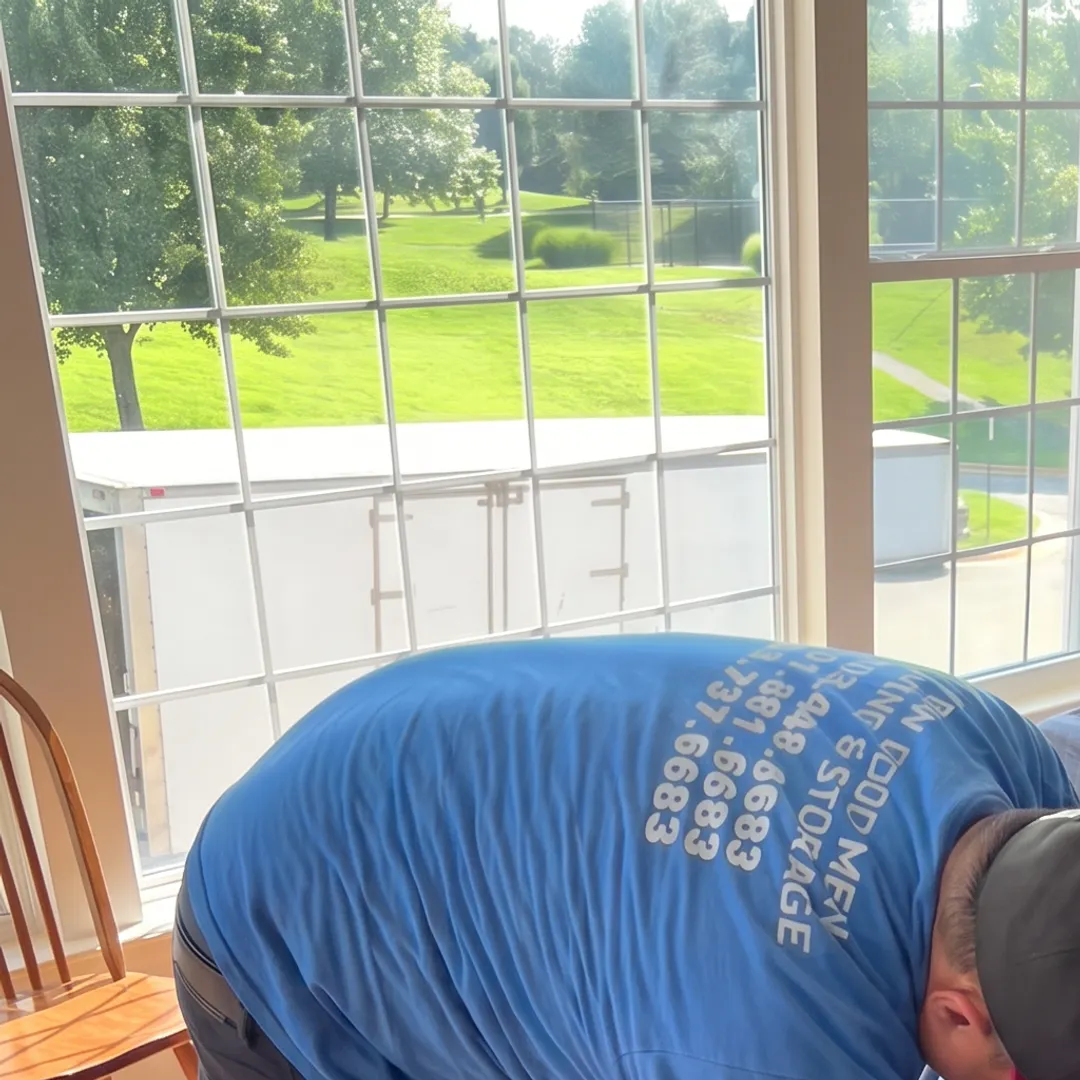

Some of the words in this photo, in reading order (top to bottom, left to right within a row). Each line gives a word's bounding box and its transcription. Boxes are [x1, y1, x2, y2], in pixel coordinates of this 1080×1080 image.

[684, 651, 838, 861] 01.881.6683
[836, 734, 867, 761] &
[776, 759, 850, 953] STORAGE
